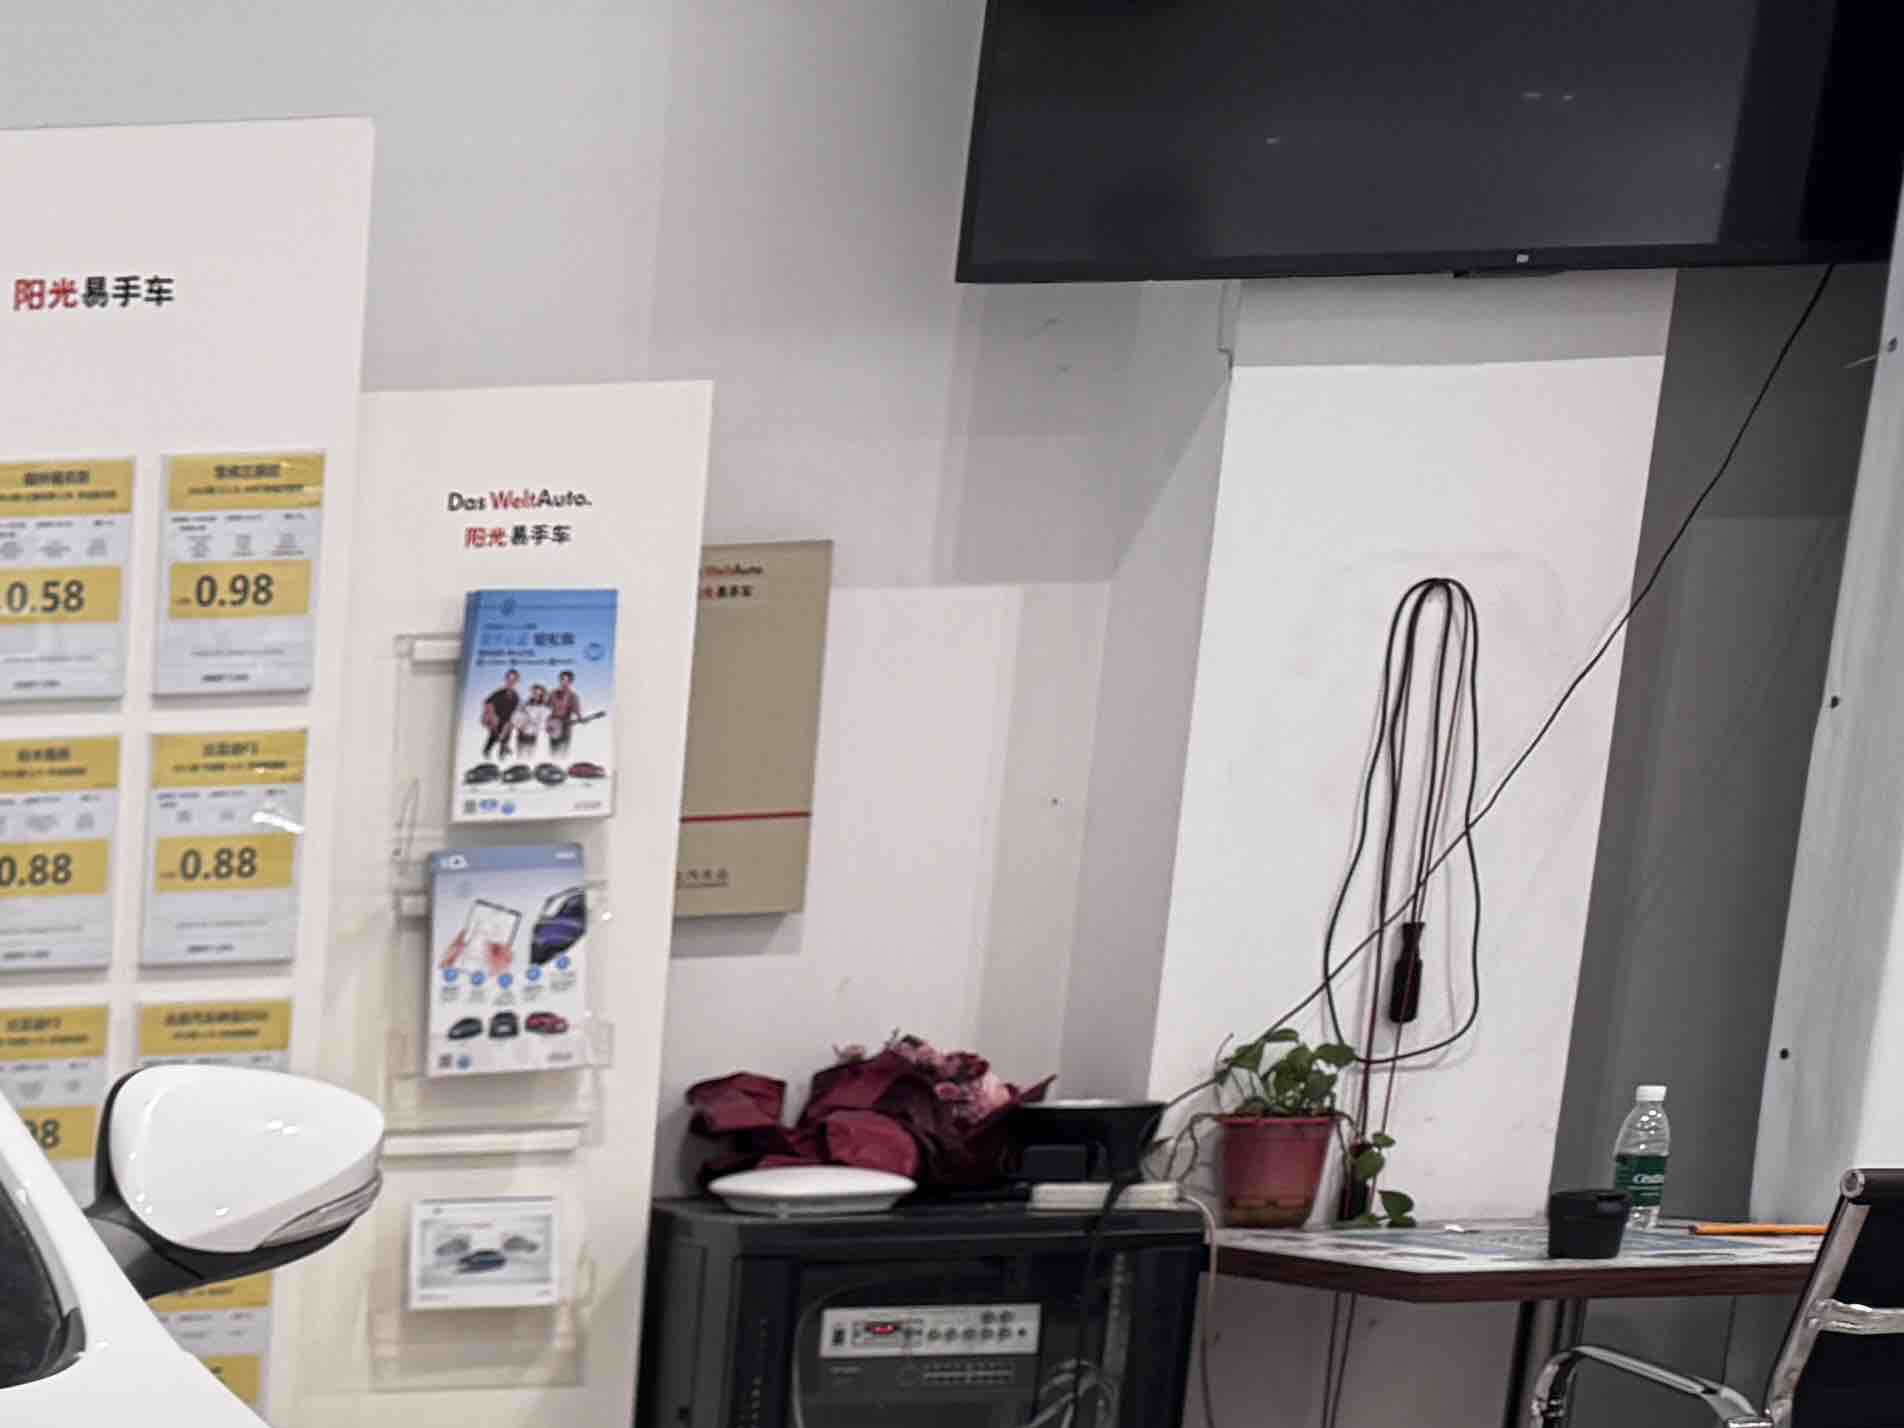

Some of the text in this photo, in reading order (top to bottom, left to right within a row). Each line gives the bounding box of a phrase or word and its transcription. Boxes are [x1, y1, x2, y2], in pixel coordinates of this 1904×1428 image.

[13, 275, 174, 311] 阳光易手车
[447, 491, 486, 511] Das
[5, 579, 85, 614] 0.58
[195, 573, 274, 608] 0.98
[179, 847, 258, 881] 0.88
